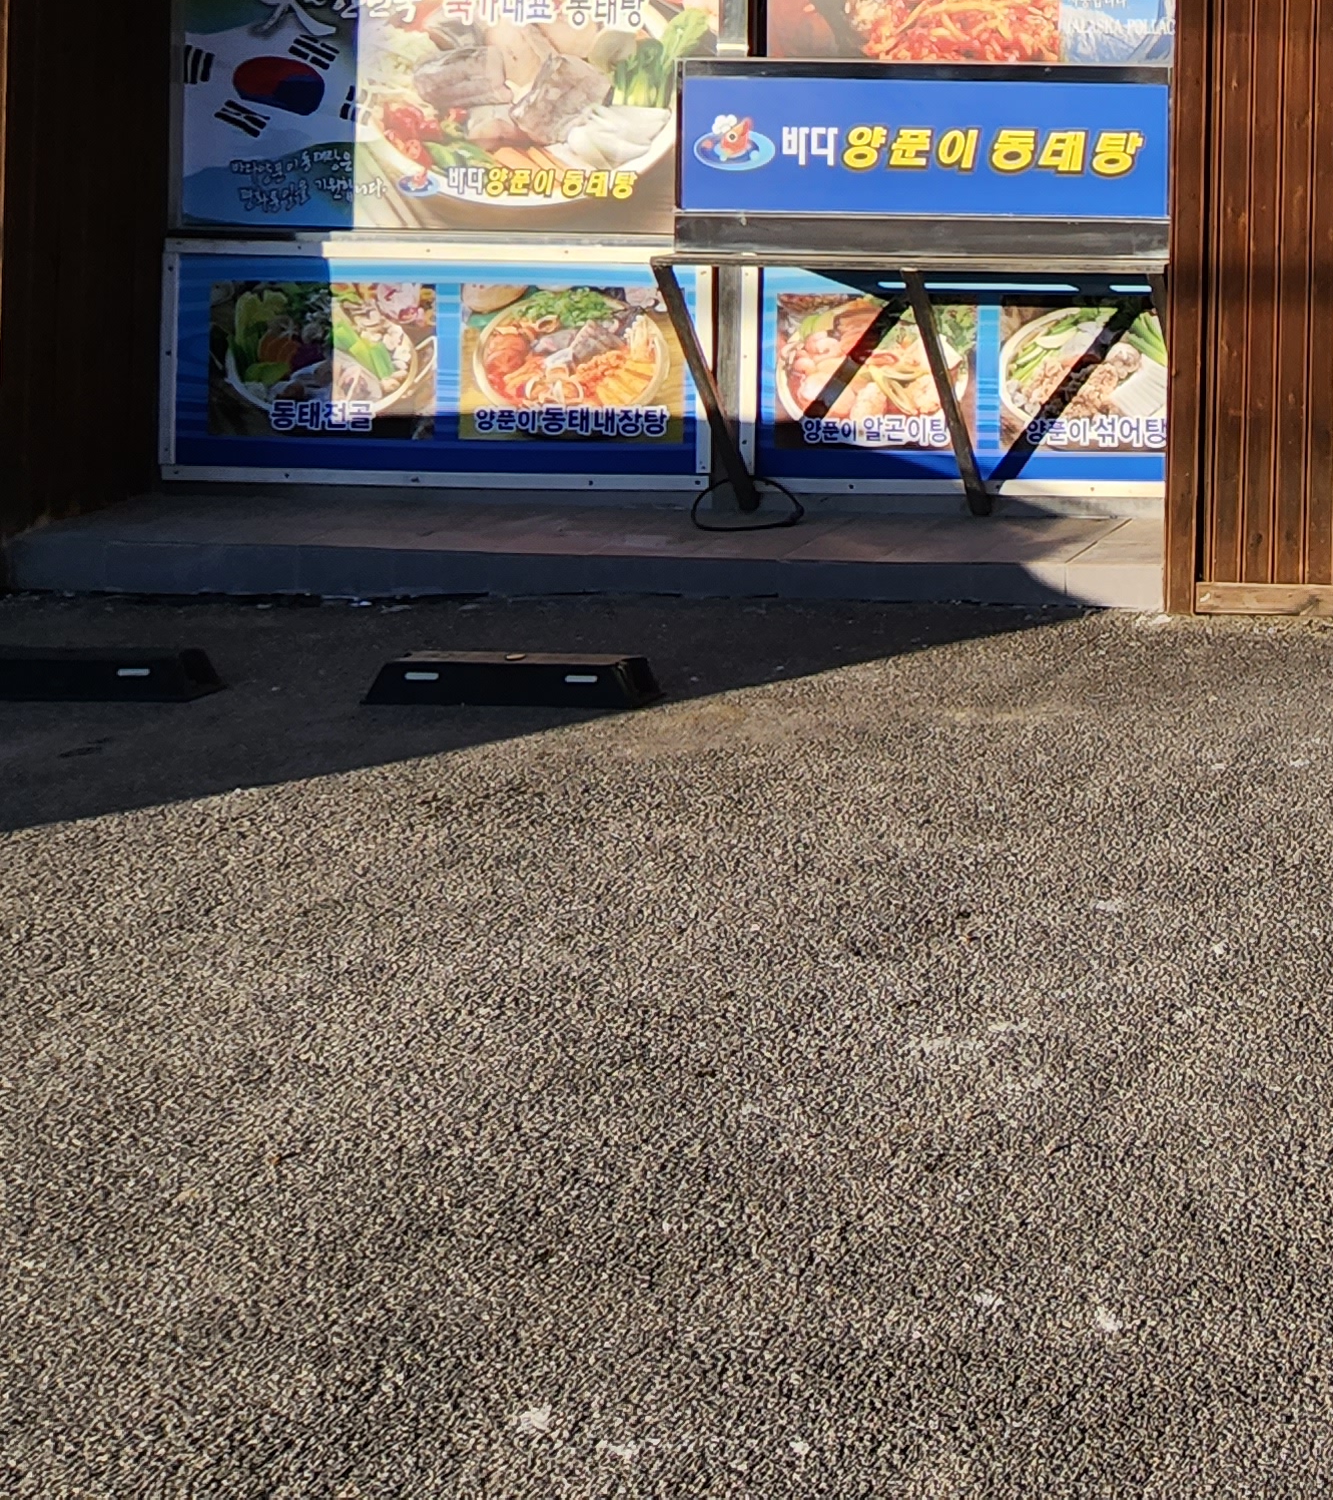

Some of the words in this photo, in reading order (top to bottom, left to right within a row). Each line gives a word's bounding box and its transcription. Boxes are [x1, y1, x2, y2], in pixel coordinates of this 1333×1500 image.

[989, 128, 1144, 177] 동태탕
[560, 169, 638, 200] 동태탕
[269, 401, 373, 432] 동태전골
